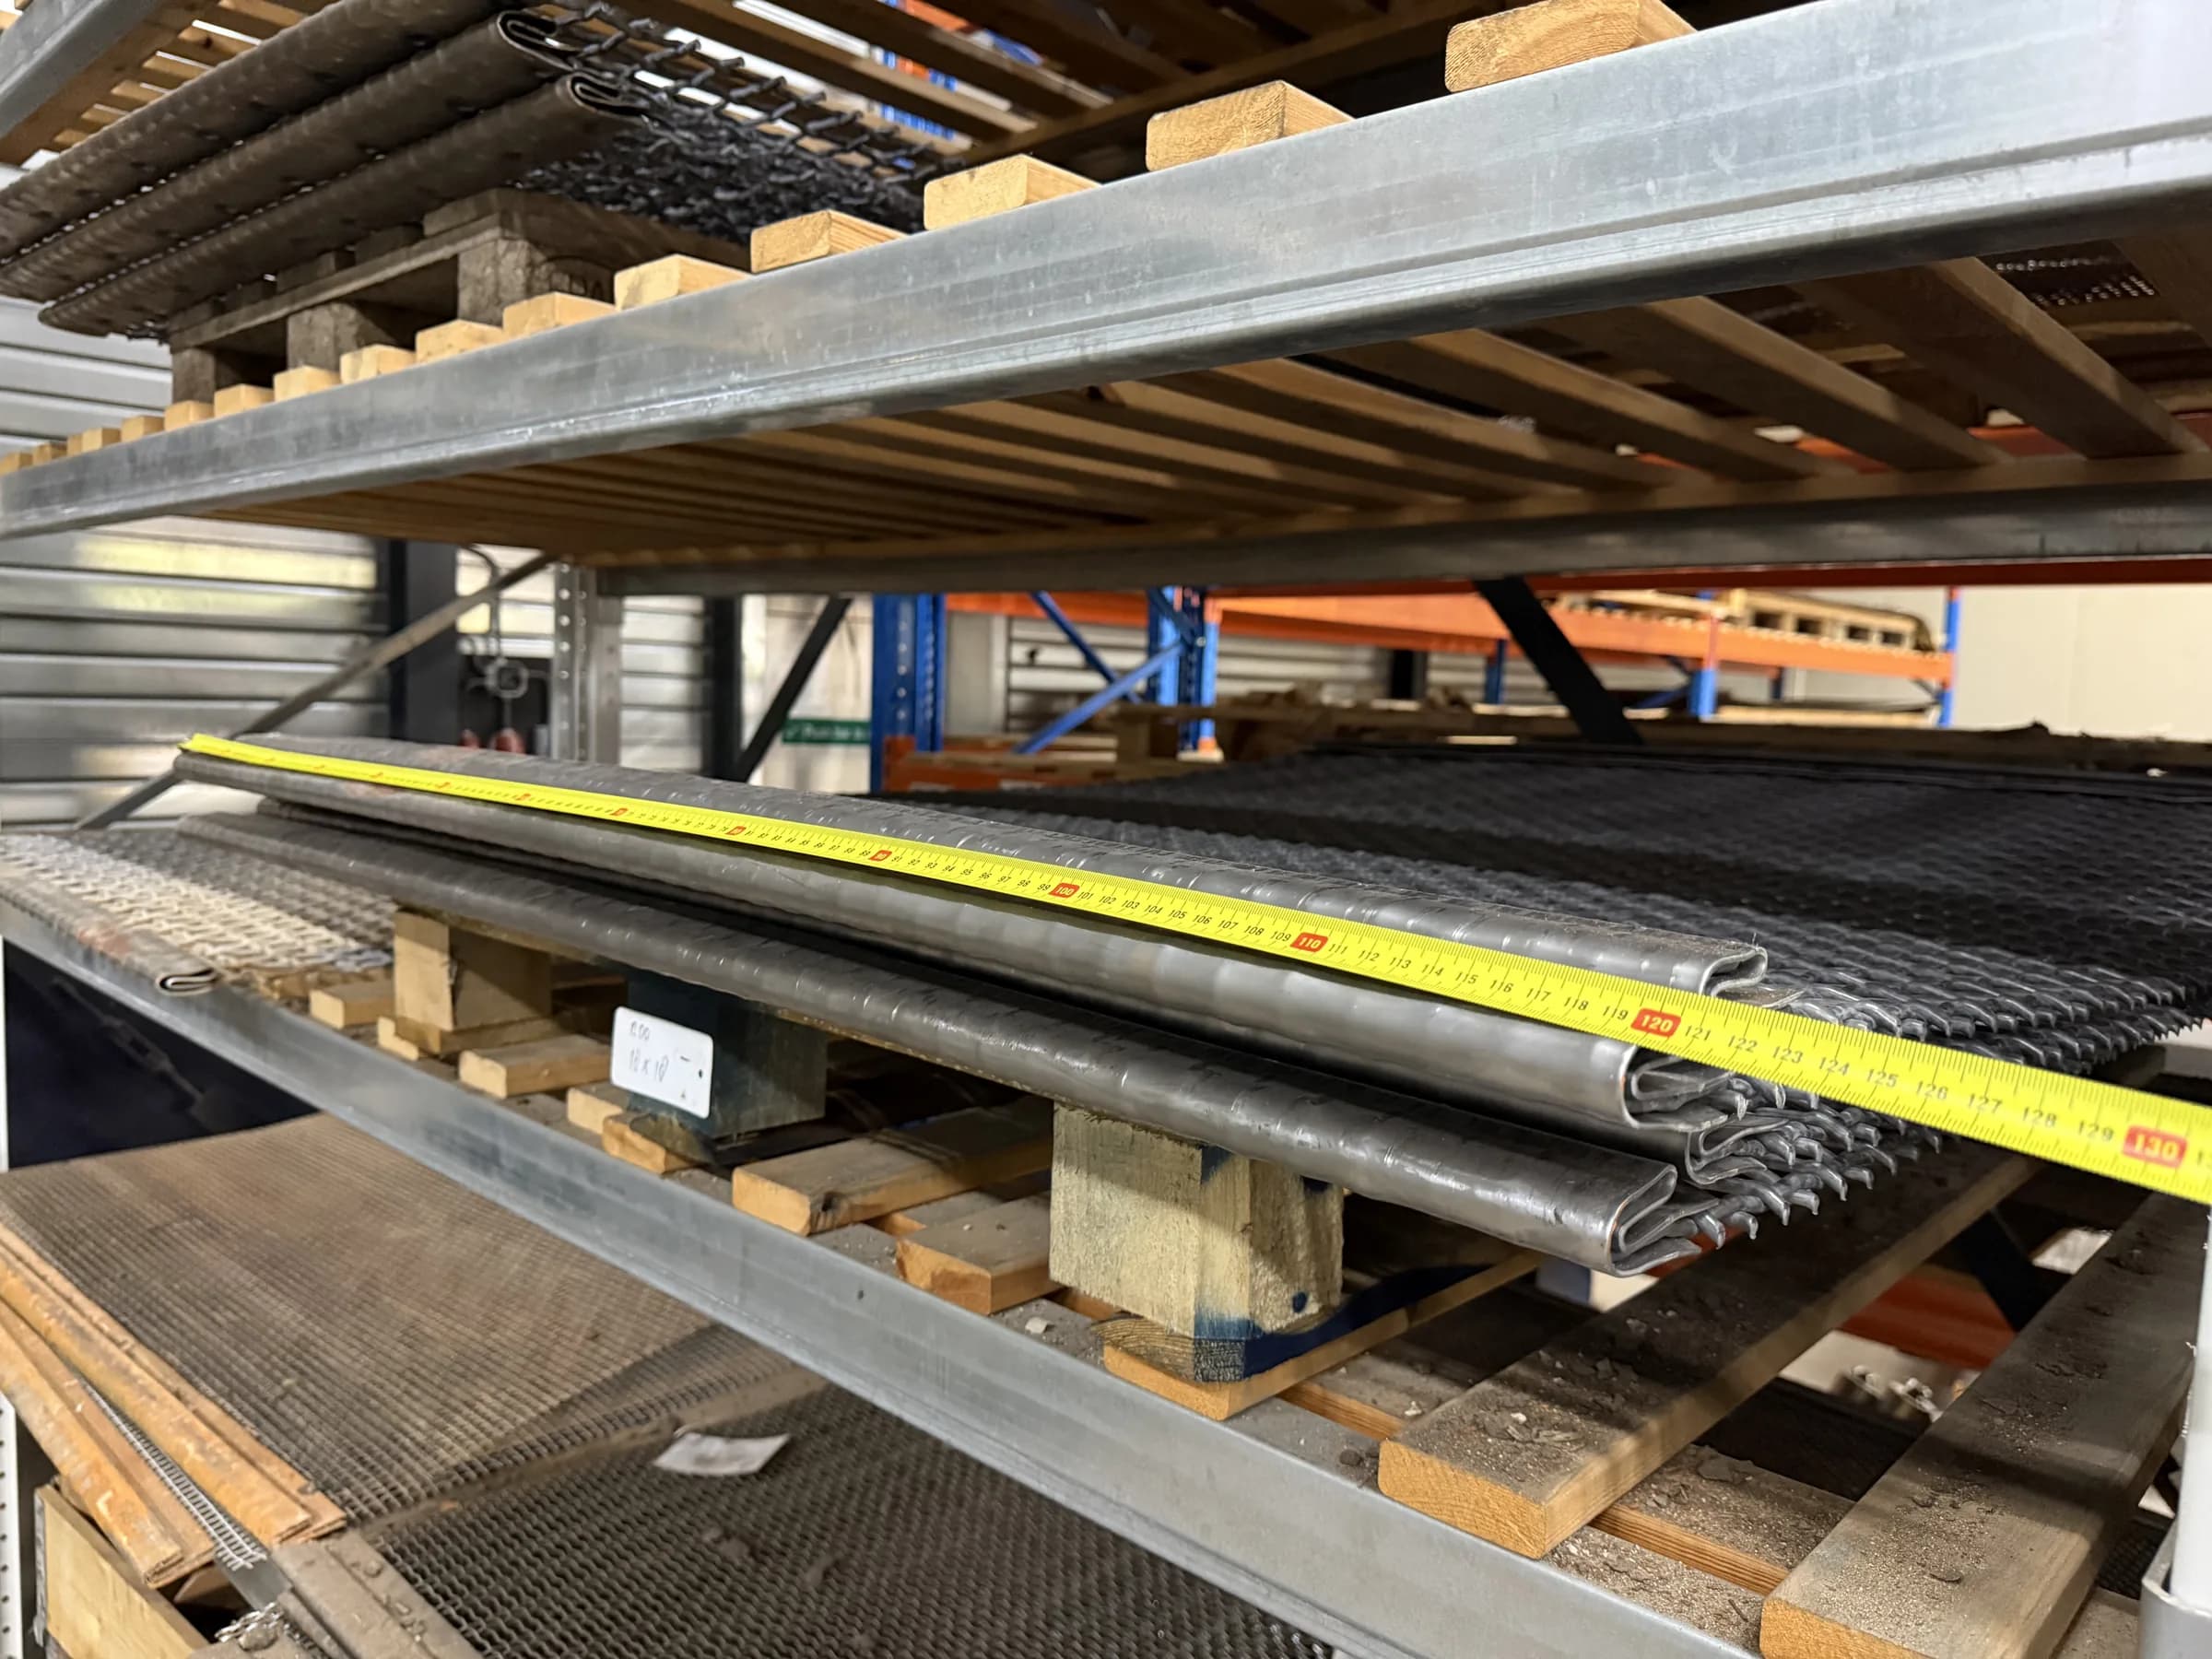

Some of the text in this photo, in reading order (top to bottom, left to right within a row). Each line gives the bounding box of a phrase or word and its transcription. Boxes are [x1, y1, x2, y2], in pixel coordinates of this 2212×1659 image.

[1054, 886, 1075, 897] 100
[1077, 891, 1094, 900] 101
[1099, 896, 1116, 904] 102
[1121, 900, 1140, 910] 103
[1144, 904, 1164, 914] 104
[1168, 910, 1187, 919] 105
[1193, 914, 1213, 924] 106
[1218, 920, 1239, 930] 107
[1243, 925, 1265, 935] 108
[1269, 931, 1291, 942] 109
[1299, 936, 1322, 949] 110
[1328, 943, 1348, 955] 111
[1358, 950, 1380, 962] 112
[1389, 957, 1412, 970] 113
[1421, 964, 1444, 977] 114
[1455, 971, 1478, 984] 115
[1489, 979, 1514, 993] 116
[1526, 987, 1551, 1002] 117
[1564, 996, 1589, 1011] 118
[1602, 1006, 1629, 1020] 119
[1640, 1014, 1674, 1033] 120
[1685, 1025, 1712, 1041] 121
[1727, 1035, 1758, 1053] 122
[1772, 1046, 1804, 1064] 123
[1818, 1056, 1851, 1076] 124
[1866, 1068, 1900, 1088] 125
[1916, 1080, 1949, 1100] 126
[1969, 1093, 2003, 1113] 127
[2022, 1106, 2058, 1128] 128
[2077, 1120, 2114, 1142] 129
[2134, 1133, 2180, 1161] 130
